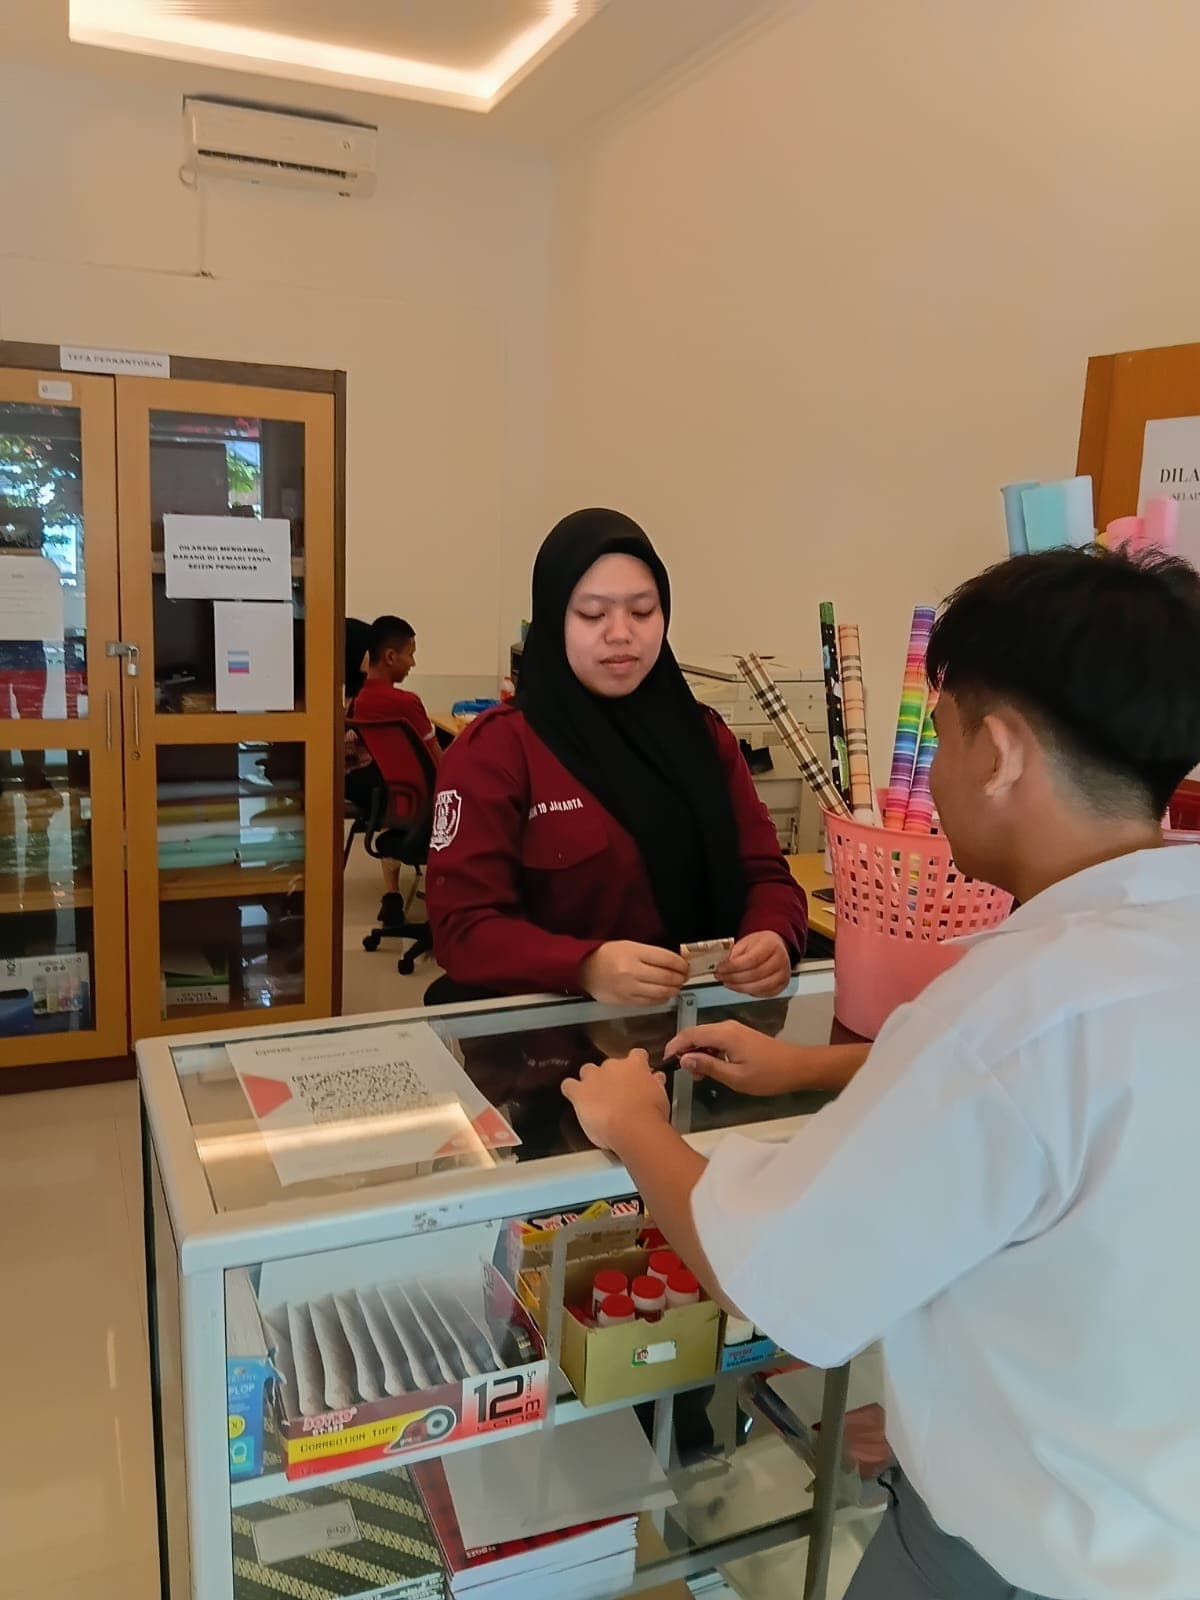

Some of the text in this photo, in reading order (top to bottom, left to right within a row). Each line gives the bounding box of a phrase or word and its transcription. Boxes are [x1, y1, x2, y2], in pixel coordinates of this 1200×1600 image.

[549, 798, 584, 812] JAKARTA
[474, 1374, 524, 1423] 12
[300, 1432, 366, 1453] CORRECTION
